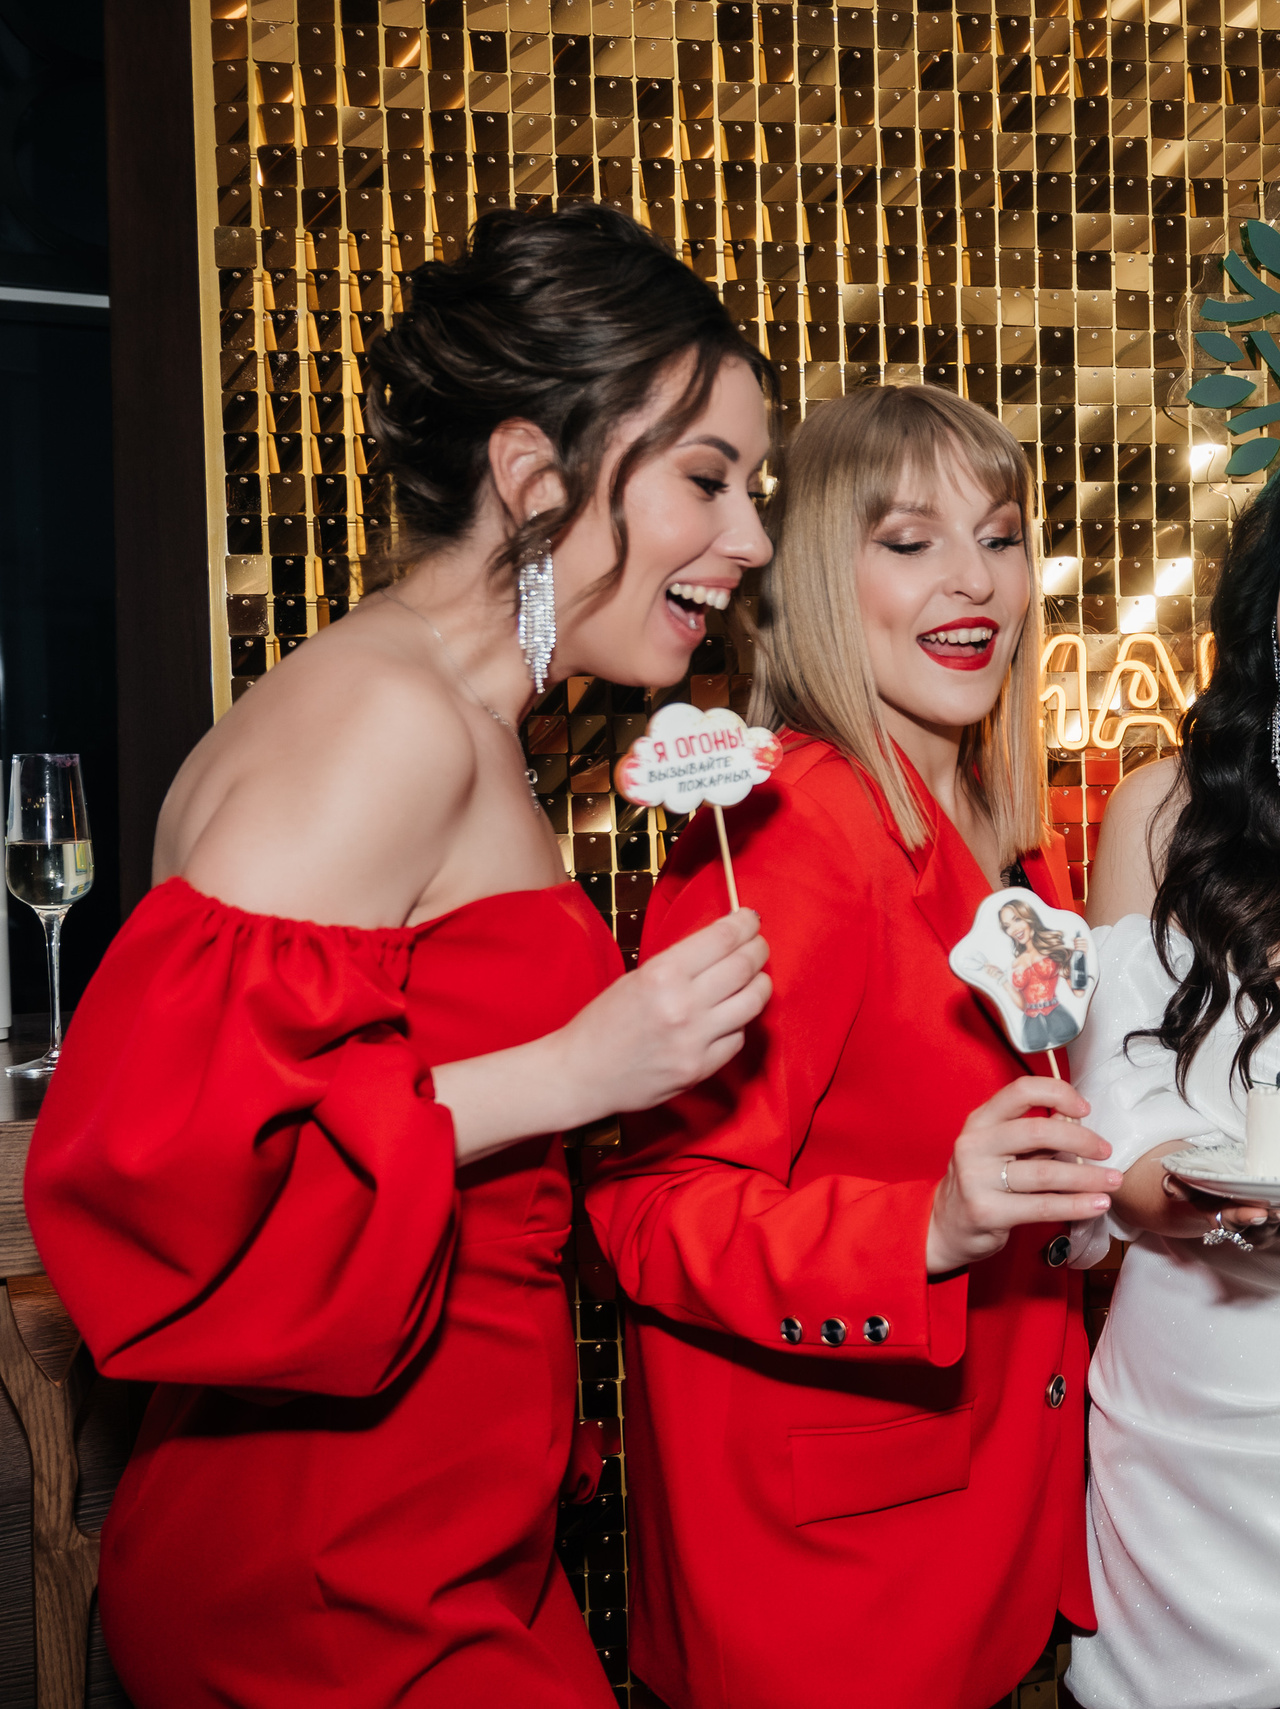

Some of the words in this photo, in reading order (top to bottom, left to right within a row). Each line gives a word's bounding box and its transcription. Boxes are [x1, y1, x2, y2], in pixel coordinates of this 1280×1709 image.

[653, 741, 668, 763] Я
[675, 727, 746, 759] ОГОНЬ!
[648, 756, 732, 783] ВЫЗЫВАЙТЕ
[677, 769, 752, 793] ПОЖАРНЫХ
